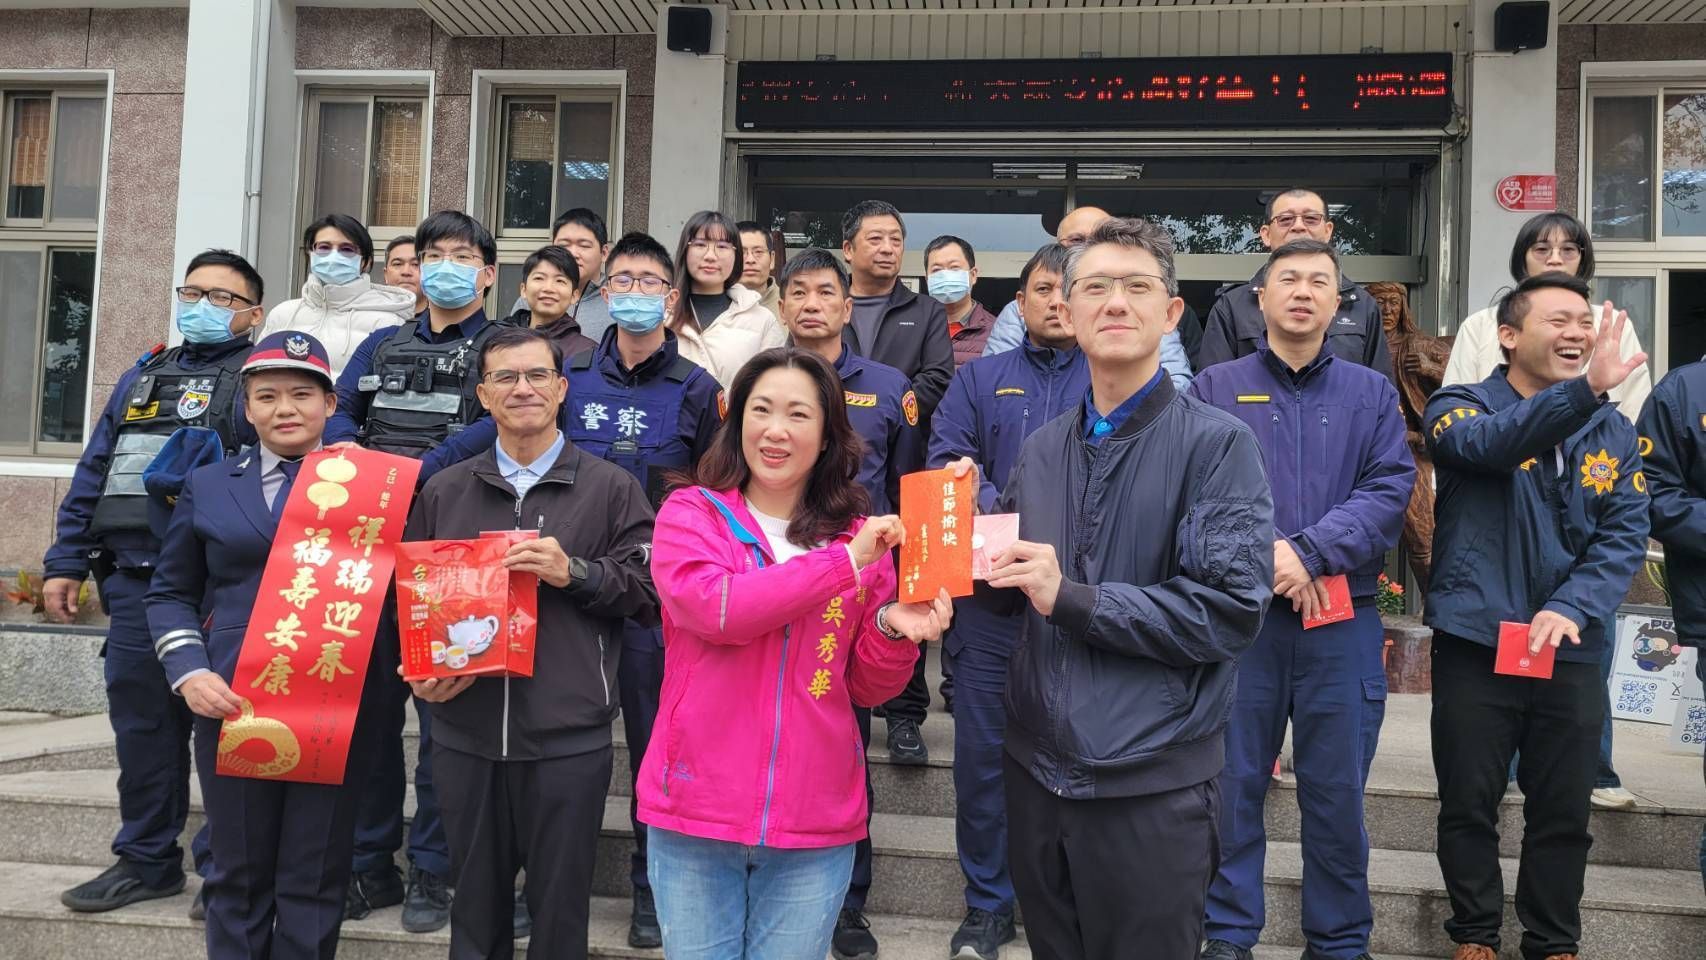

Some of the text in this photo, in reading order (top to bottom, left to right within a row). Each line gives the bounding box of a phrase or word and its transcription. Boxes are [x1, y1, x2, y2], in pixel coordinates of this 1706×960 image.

[580, 402, 648, 437] 警察
[941, 480, 958, 547] 佳節愉快
[251, 527, 334, 696] 福壽安康
[307, 515, 387, 683] 祥瑞迎春
[807, 596, 846, 700] 吳秀華
